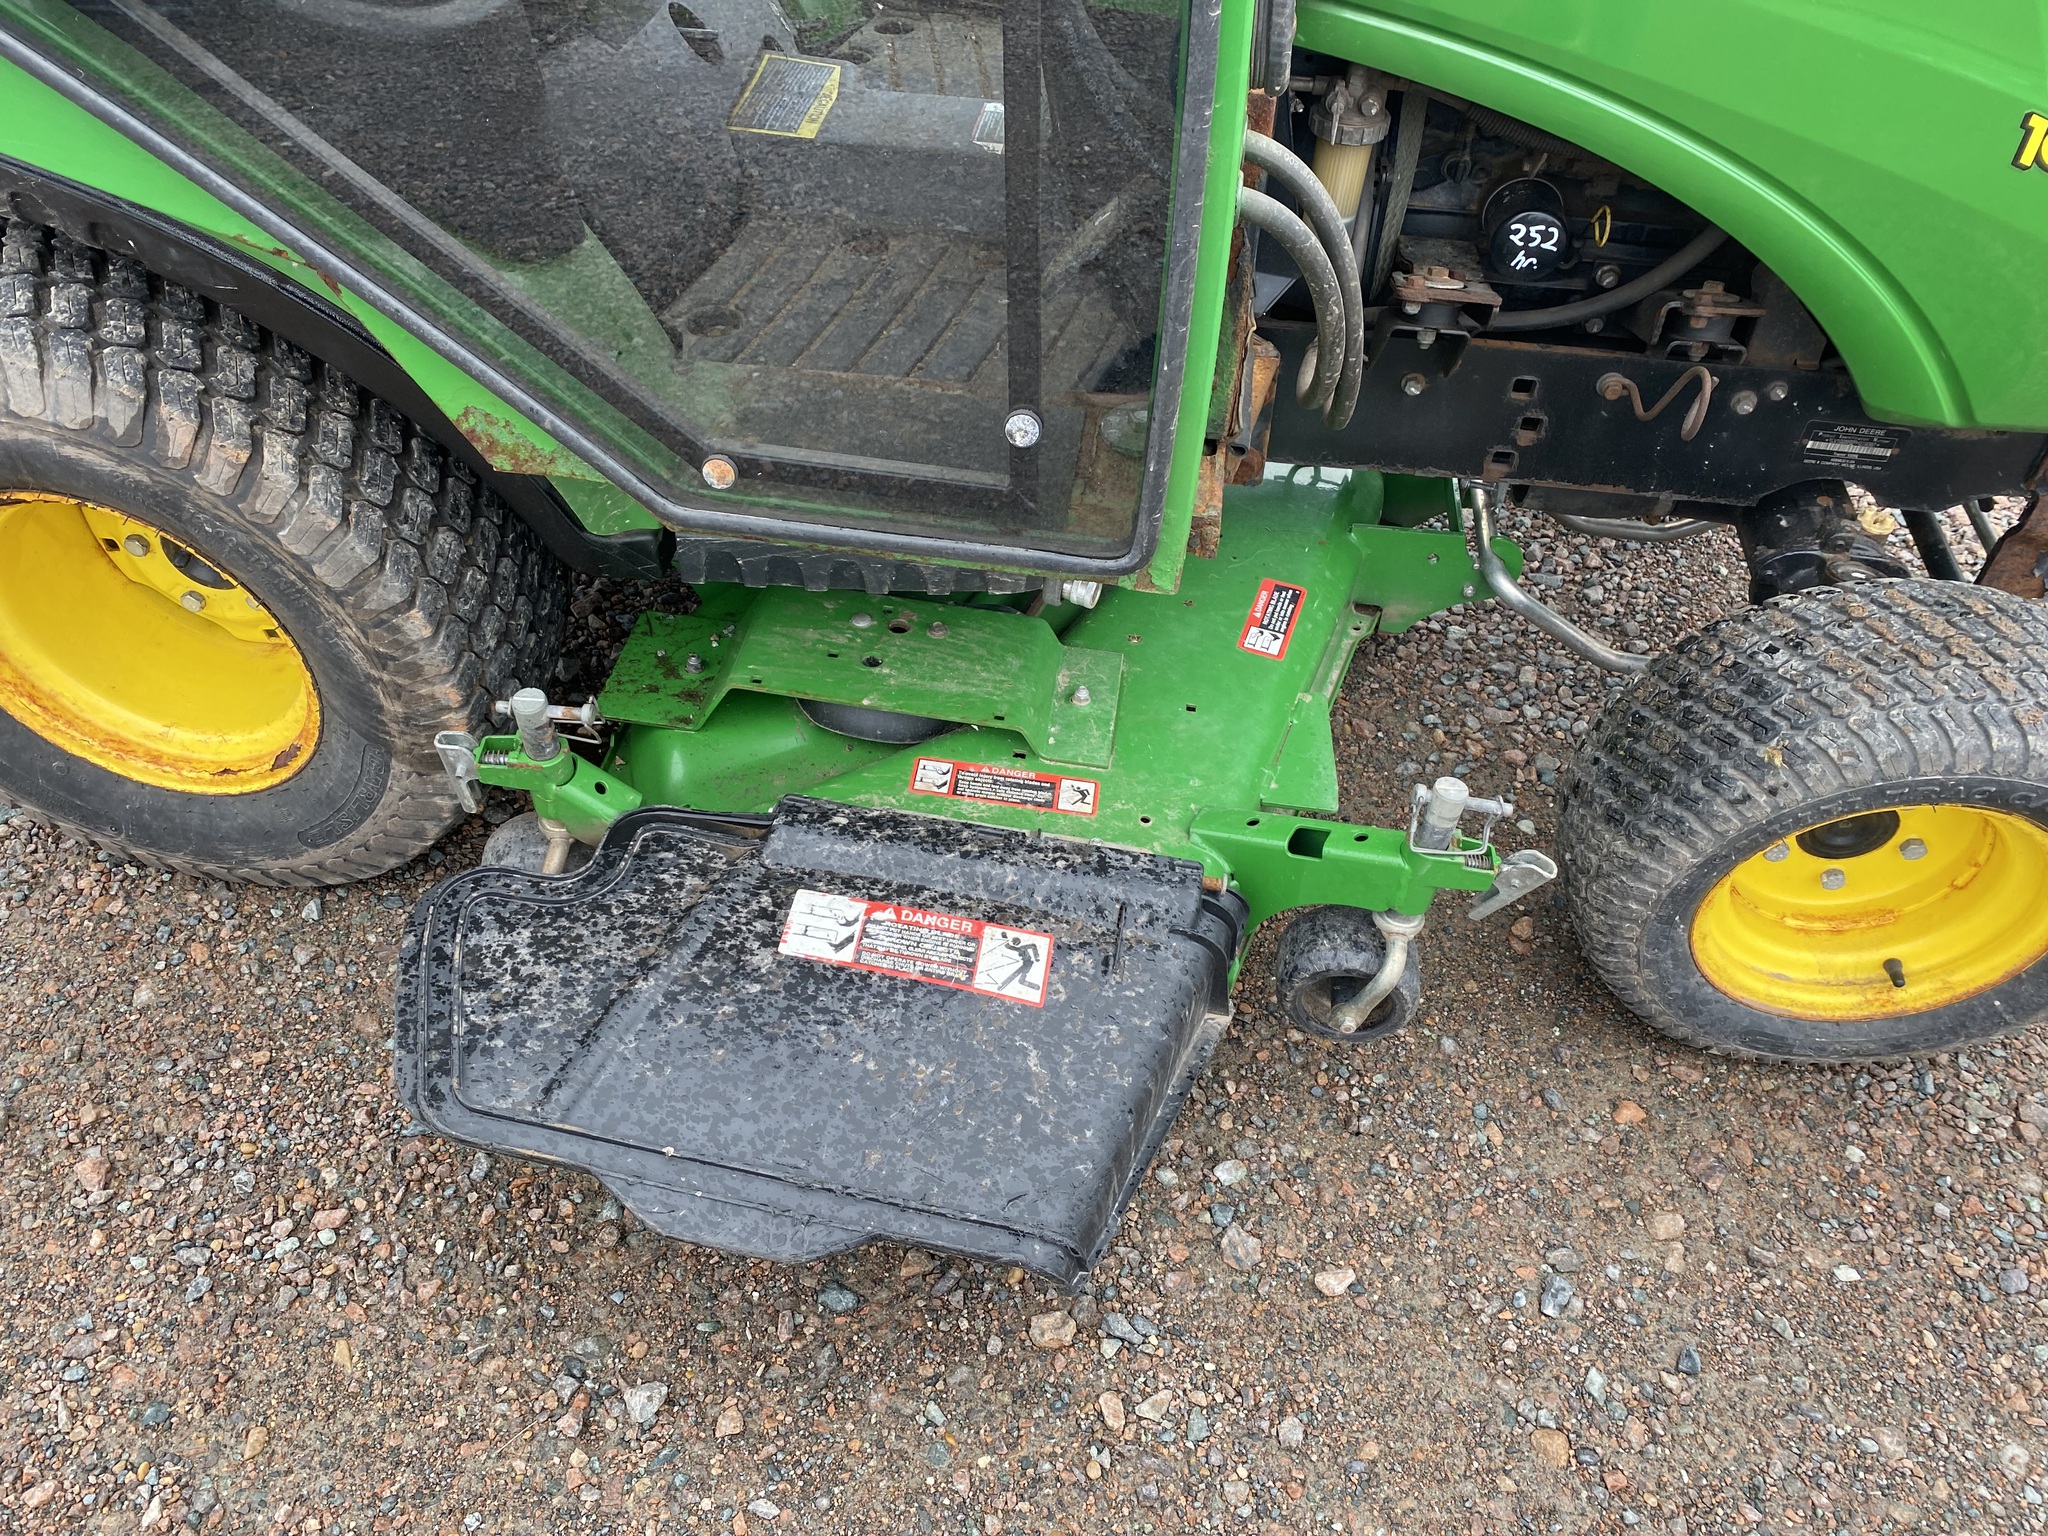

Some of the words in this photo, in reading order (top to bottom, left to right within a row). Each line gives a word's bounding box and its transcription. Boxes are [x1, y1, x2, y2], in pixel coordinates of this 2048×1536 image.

[1283, 153, 1300, 169] 200
[1508, 223, 1559, 252] 252
[1859, 428, 1887, 436] DEERE
[1255, 590, 1270, 613] DANGER
[992, 767, 1036, 779] DANGER
[309, 752, 385, 845] CARLISLE
[900, 909, 973, 933] DANGER
[886, 956, 915, 965] OPERATE
